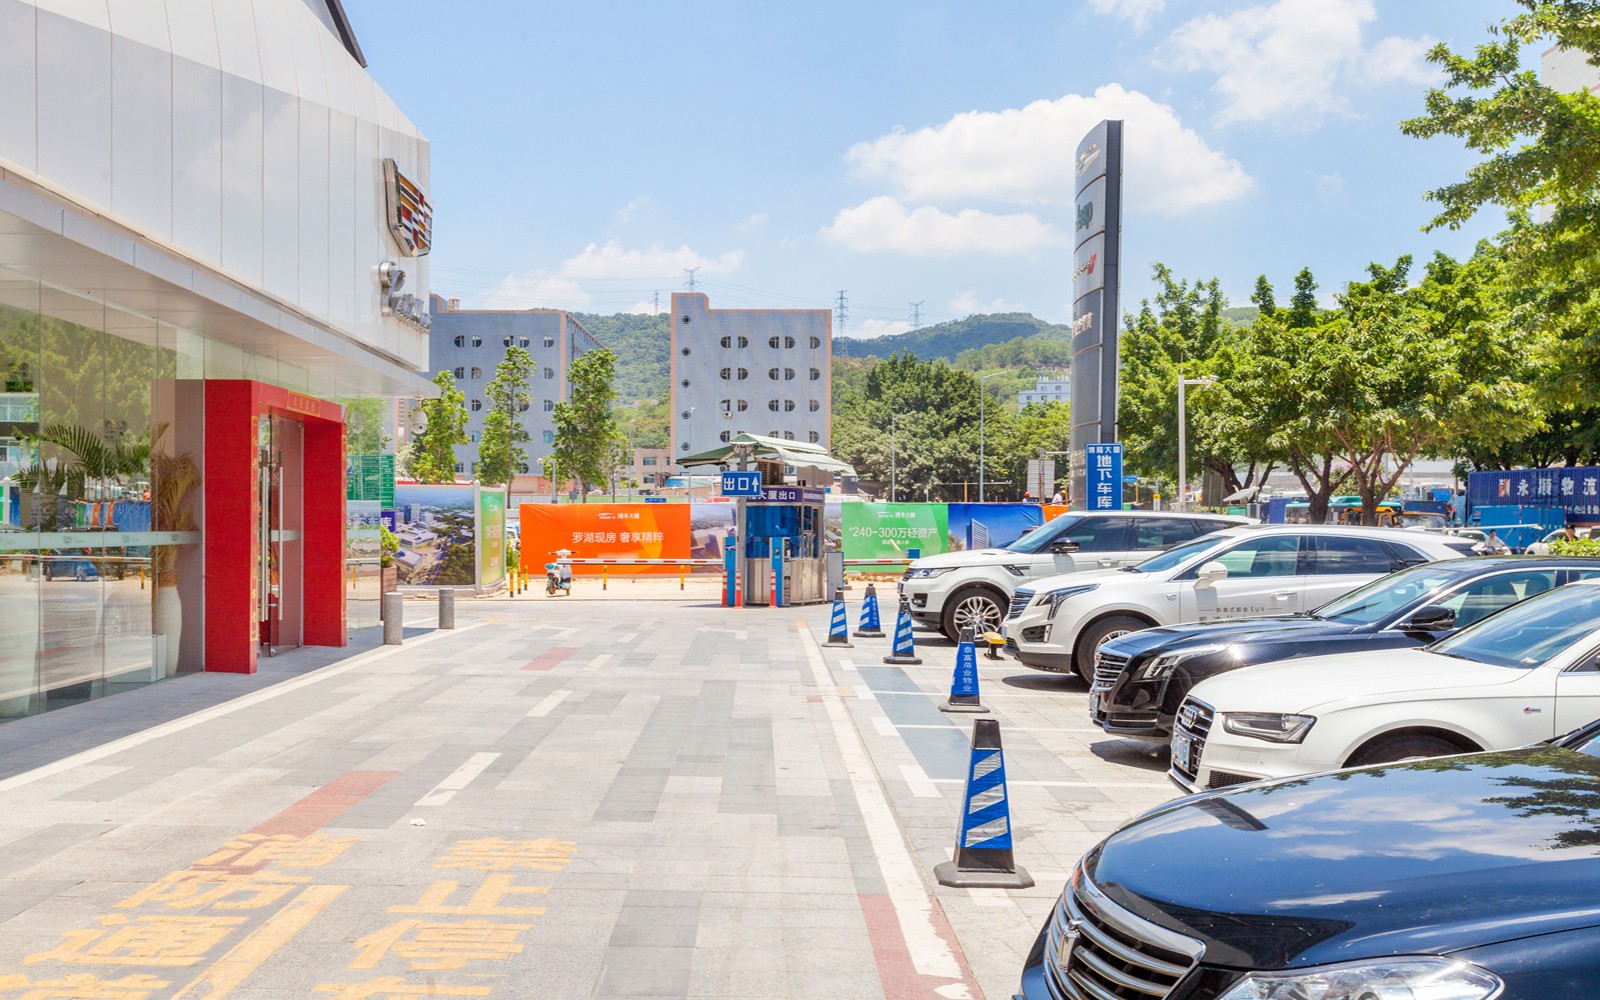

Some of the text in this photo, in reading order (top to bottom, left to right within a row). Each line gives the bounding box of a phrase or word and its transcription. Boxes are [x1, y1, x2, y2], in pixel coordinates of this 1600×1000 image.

[723, 477, 749, 491] 出口
[1096, 454, 1112, 508] 地下车库
[1516, 476, 1597, 497] 永顺物流
[572, 531, 616, 543] 罗湖现房
